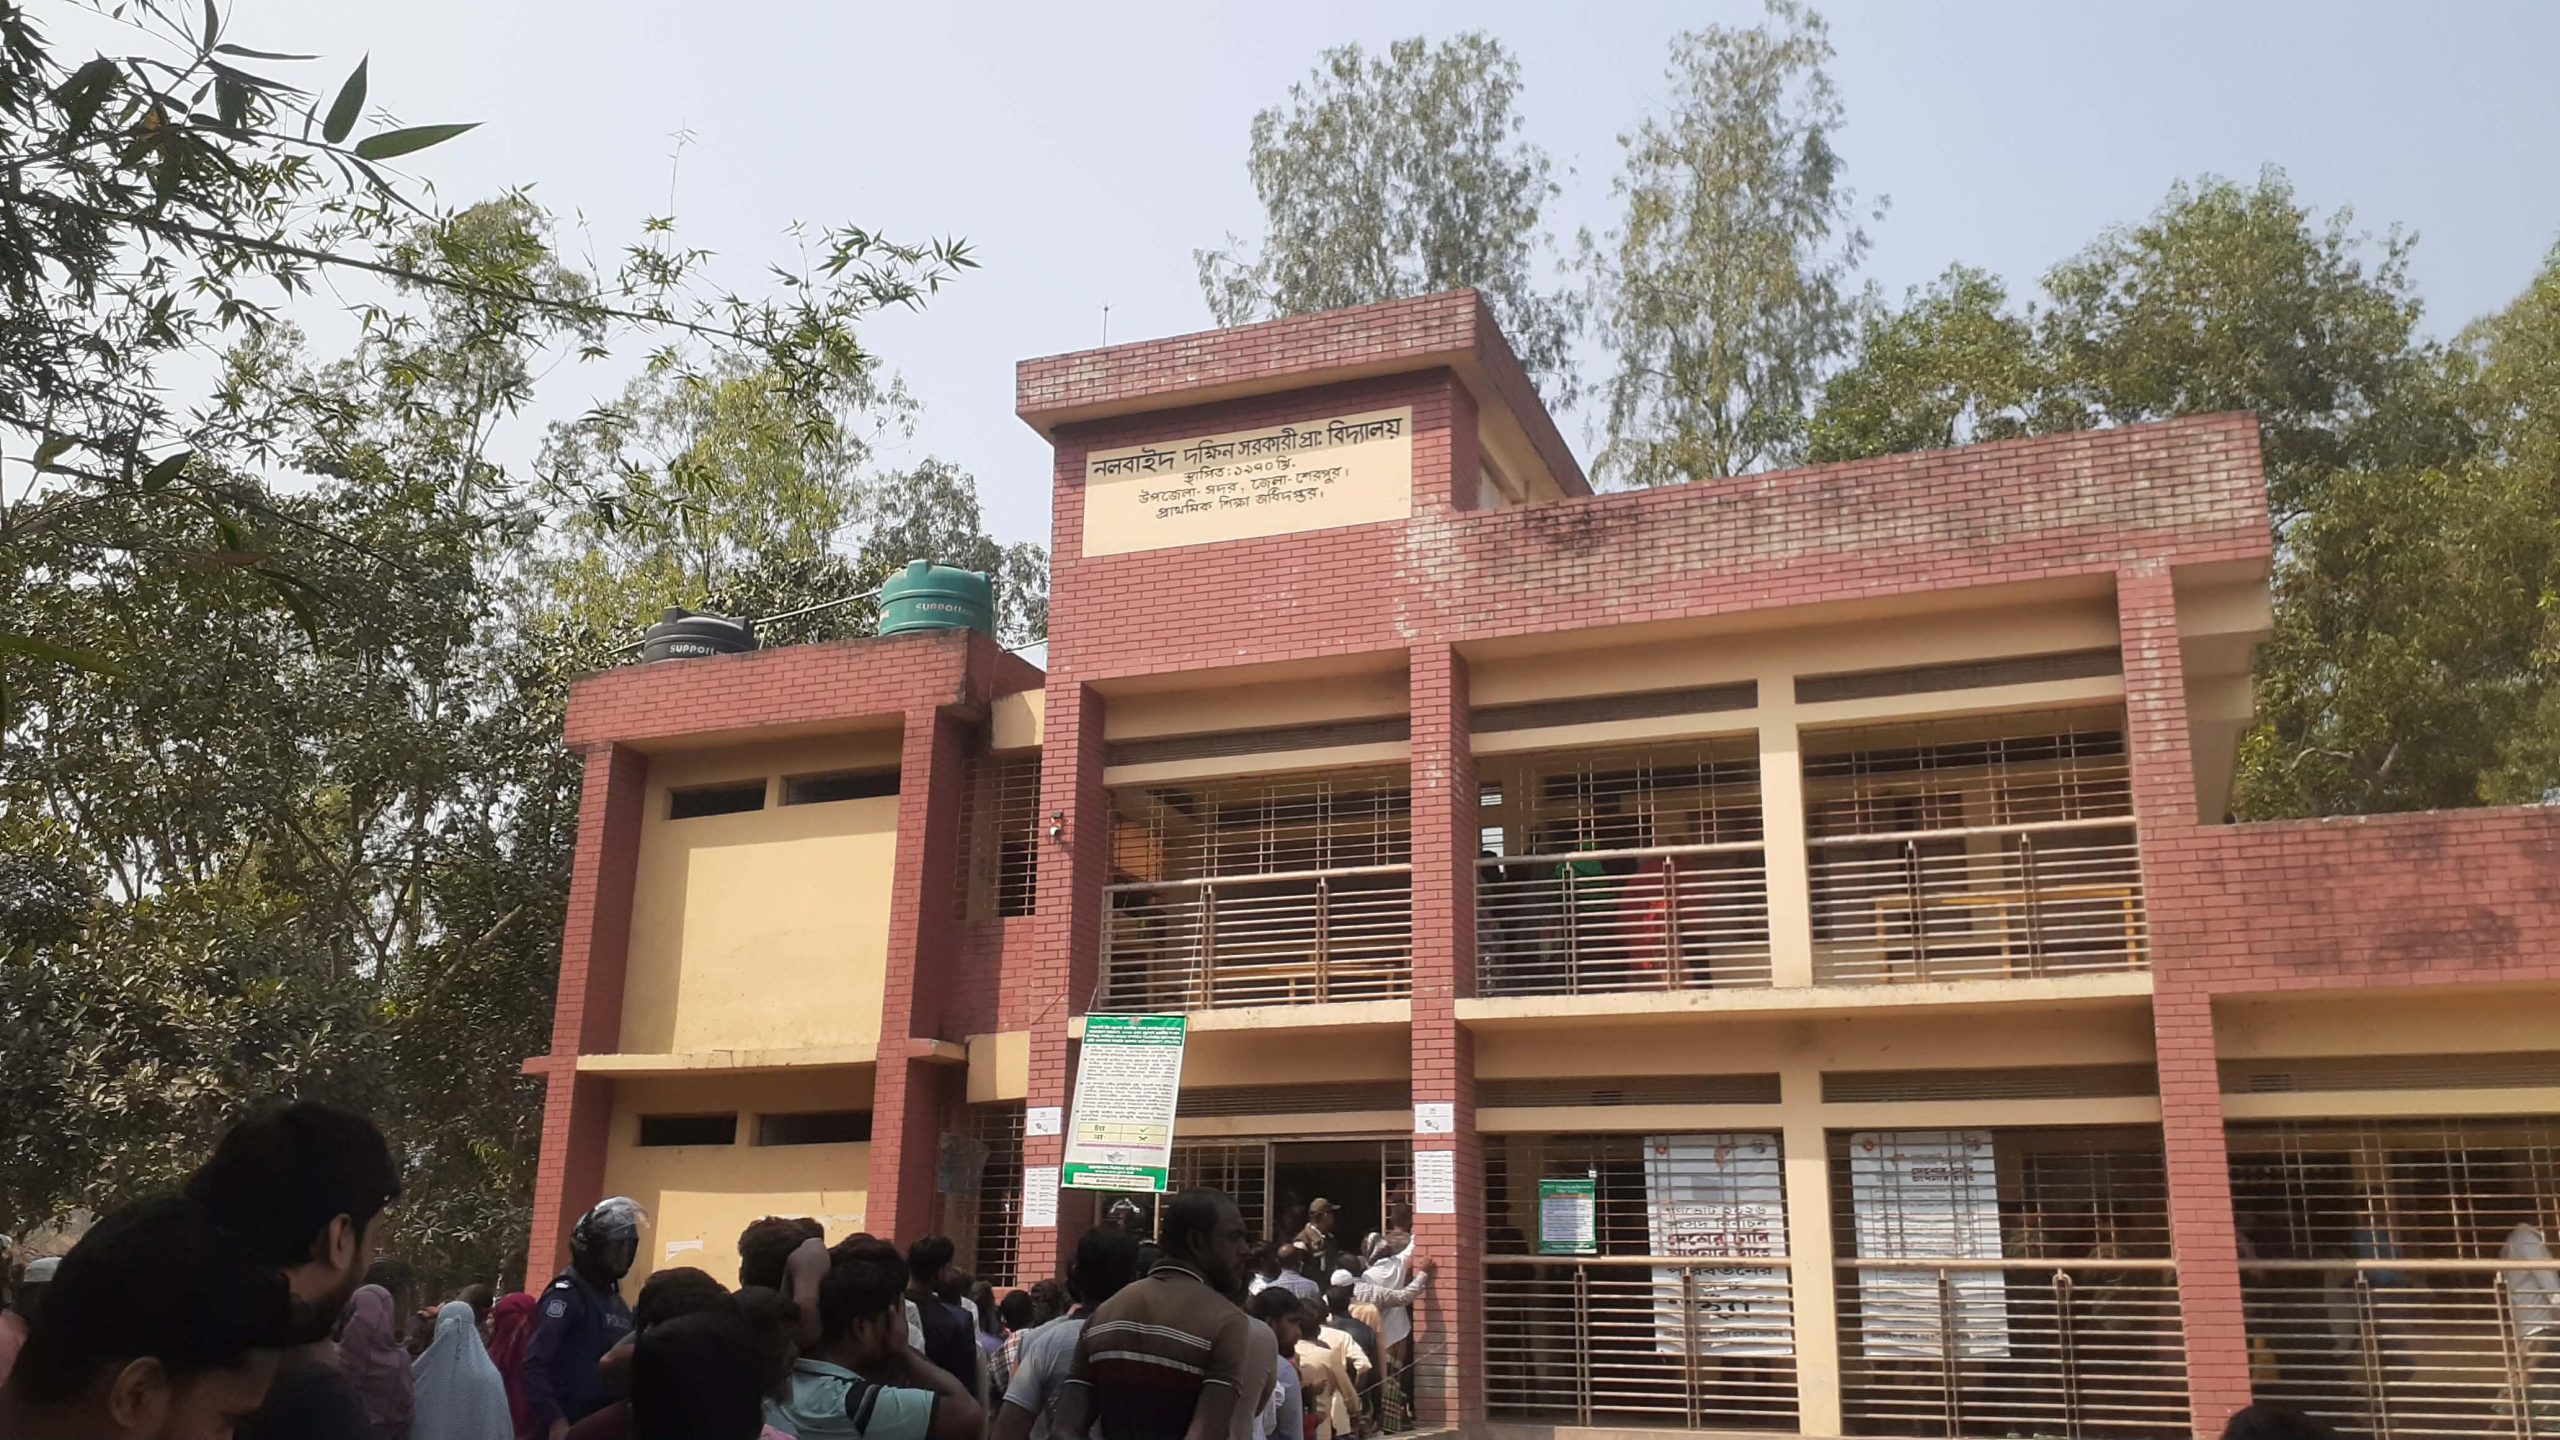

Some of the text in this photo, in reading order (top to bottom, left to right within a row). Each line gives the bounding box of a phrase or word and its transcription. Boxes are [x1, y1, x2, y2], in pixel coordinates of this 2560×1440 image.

[1091, 446, 1177, 477] নলবাইদ
[1238, 427, 1298, 457] সরকারী
[1327, 418, 1403, 446] বিদ্যালয়
[1156, 498, 1213, 520] প্রাথমিক
[1218, 495, 1251, 510] শিক্ষা
